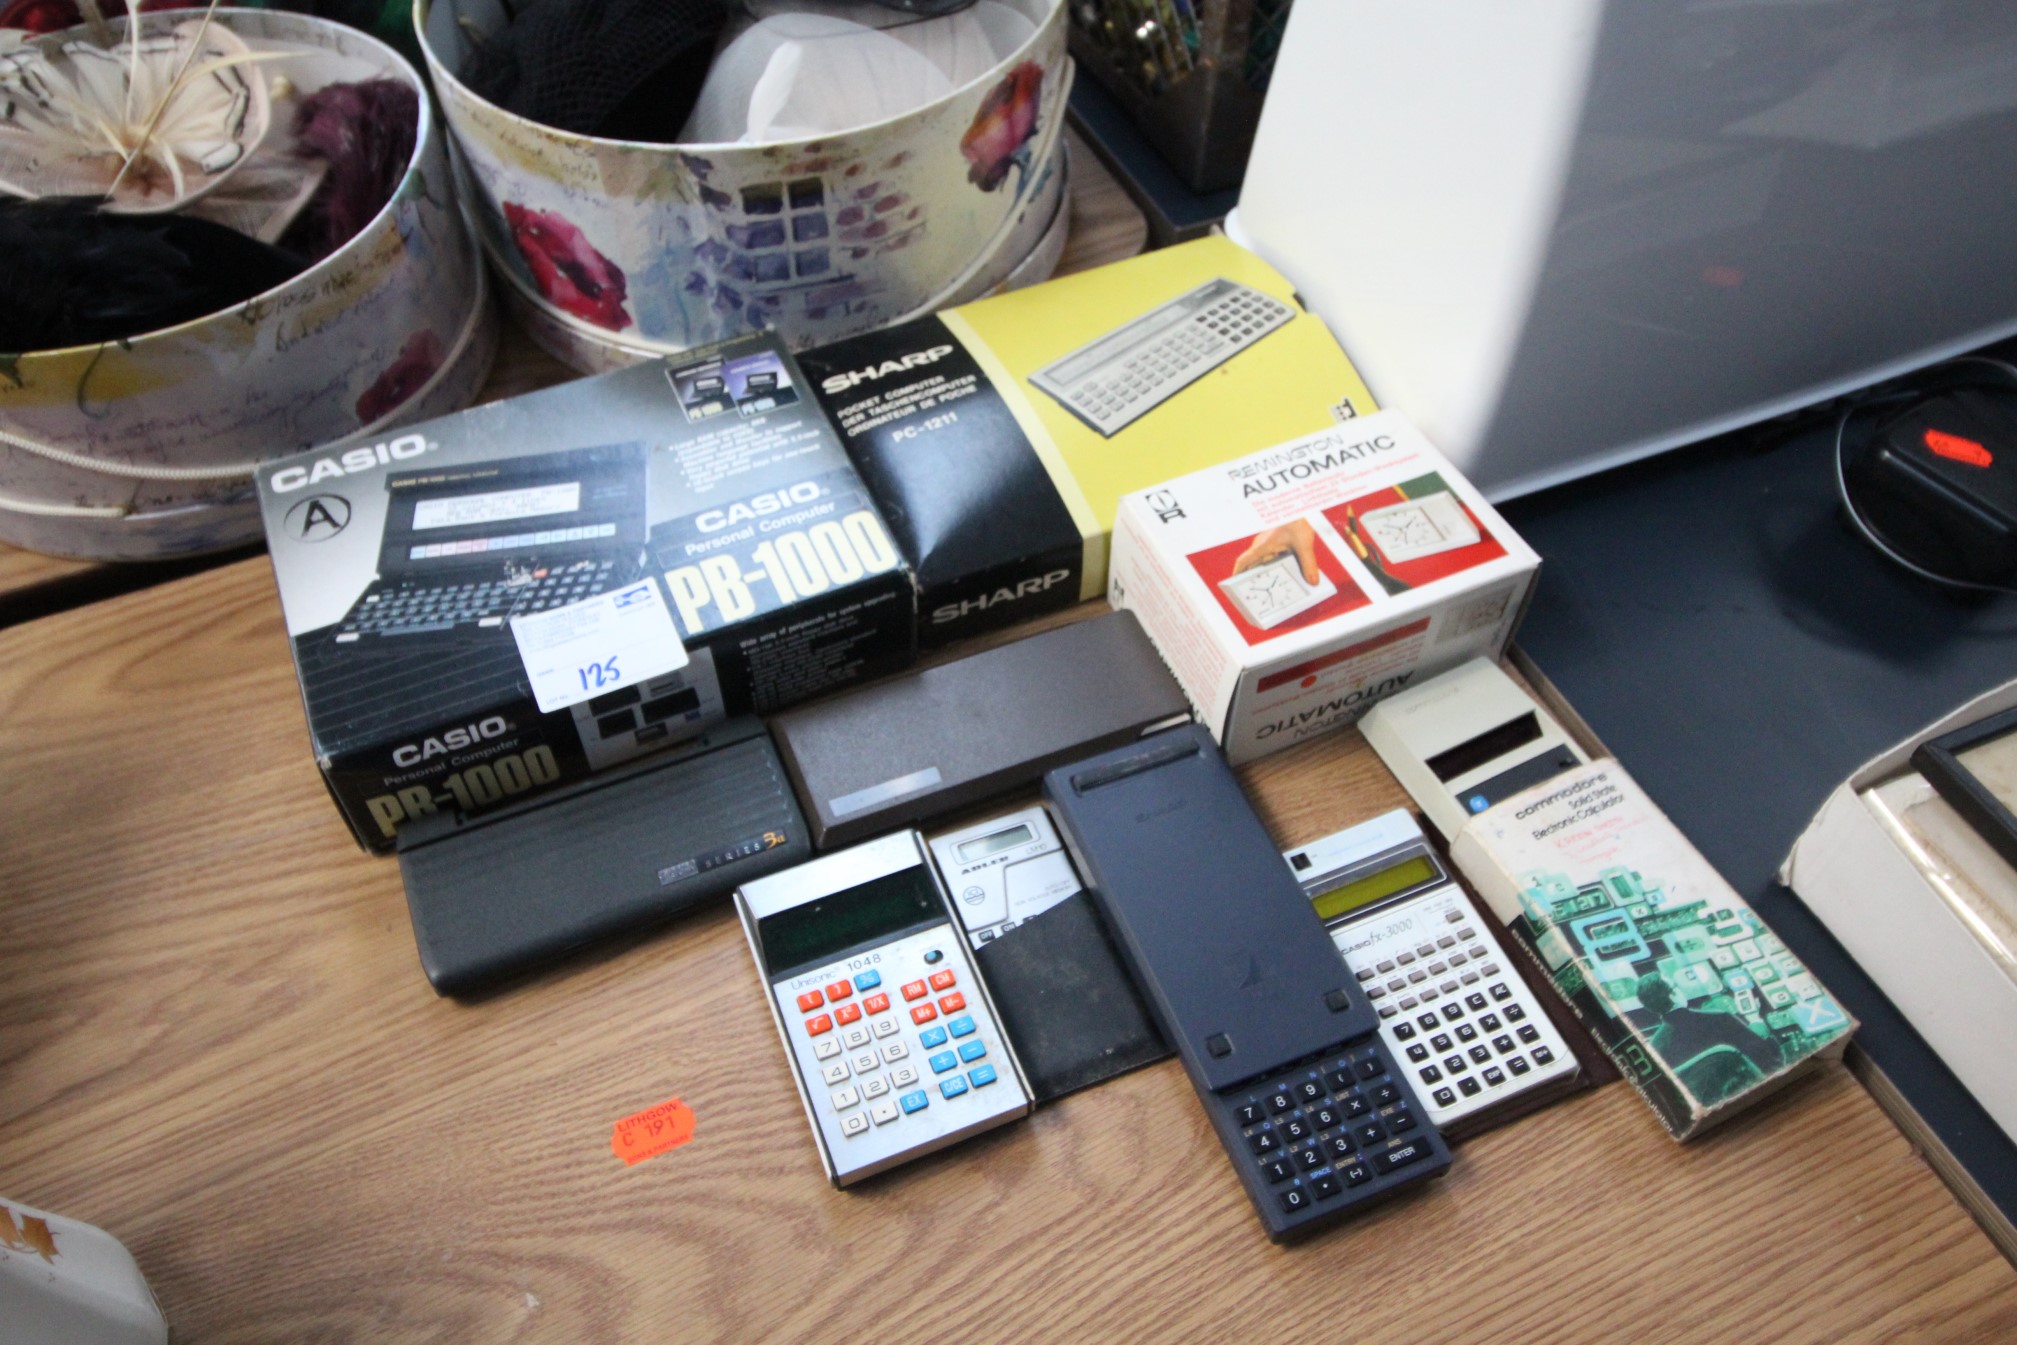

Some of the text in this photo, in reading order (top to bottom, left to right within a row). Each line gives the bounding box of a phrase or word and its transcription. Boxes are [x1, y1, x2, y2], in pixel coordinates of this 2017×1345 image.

[822, 345, 953, 394] SHARP
[837, 375, 945, 419] POCKET COMPUTER
[842, 375, 976, 428] DER TASCHENCOMPUTER
[847, 384, 977, 437] ORDINATEUR DE POCHE
[892, 411, 958, 443] PC-1211
[270, 434, 427, 493] CASIO
[1228, 434, 1344, 481] REMINGTON
[1242, 435, 1395, 498] AUTOMATIC
[301, 499, 341, 538] A
[695, 481, 821, 533] CASIO
[684, 501, 836, 556] Personal Computer
[664, 510, 898, 635] PB-1000
[932, 568, 1070, 624] SHARP
[579, 655, 620, 690] 125
[1256, 670, 1415, 739] AUTOMATIC
[392, 716, 506, 767] CASIO
[383, 738, 520, 786] Personal Computer
[1515, 772, 1608, 820] commodore
[1568, 784, 1616, 810] Solid State
[1532, 794, 1624, 840] Electronic Calculator
[1341, 918, 1412, 955] CASIO fx-3000
[791, 954, 882, 990] Unisonic 1048
[908, 983, 923, 995] RM
[935, 973, 951, 984] CM
[1511, 928, 1583, 1020] commodore
[1400, 1026, 1409, 1034] 7
[1424, 1017, 1434, 1025] 8
[1448, 1007, 1458, 1015] 9
[1471, 996, 1482, 1005] C
[821, 1021, 891, 1052] 7 8 9
[1413, 1027, 1471, 1055] 4 5 6
[831, 1045, 901, 1077] 4 5 6
[1451, 1059, 1461, 1067] 2
[1475, 1049, 1485, 1058] 3
[869, 1081, 882, 1092] 2
[899, 1069, 911, 1080] 3
[617, 1103, 677, 1132] LITHGOW
[1244, 1084, 1317, 1119] 7 8 9
[622, 1115, 675, 1146] C 191
[848, 1117, 861, 1129] 0
[1260, 1111, 1331, 1147] 4 5 6
[1274, 1139, 1346, 1175] 1 2 3
[1288, 1192, 1300, 1204] 0
[1388, 1146, 1416, 1163] ENTER
[1309, 1167, 1331, 1179] SPACE
